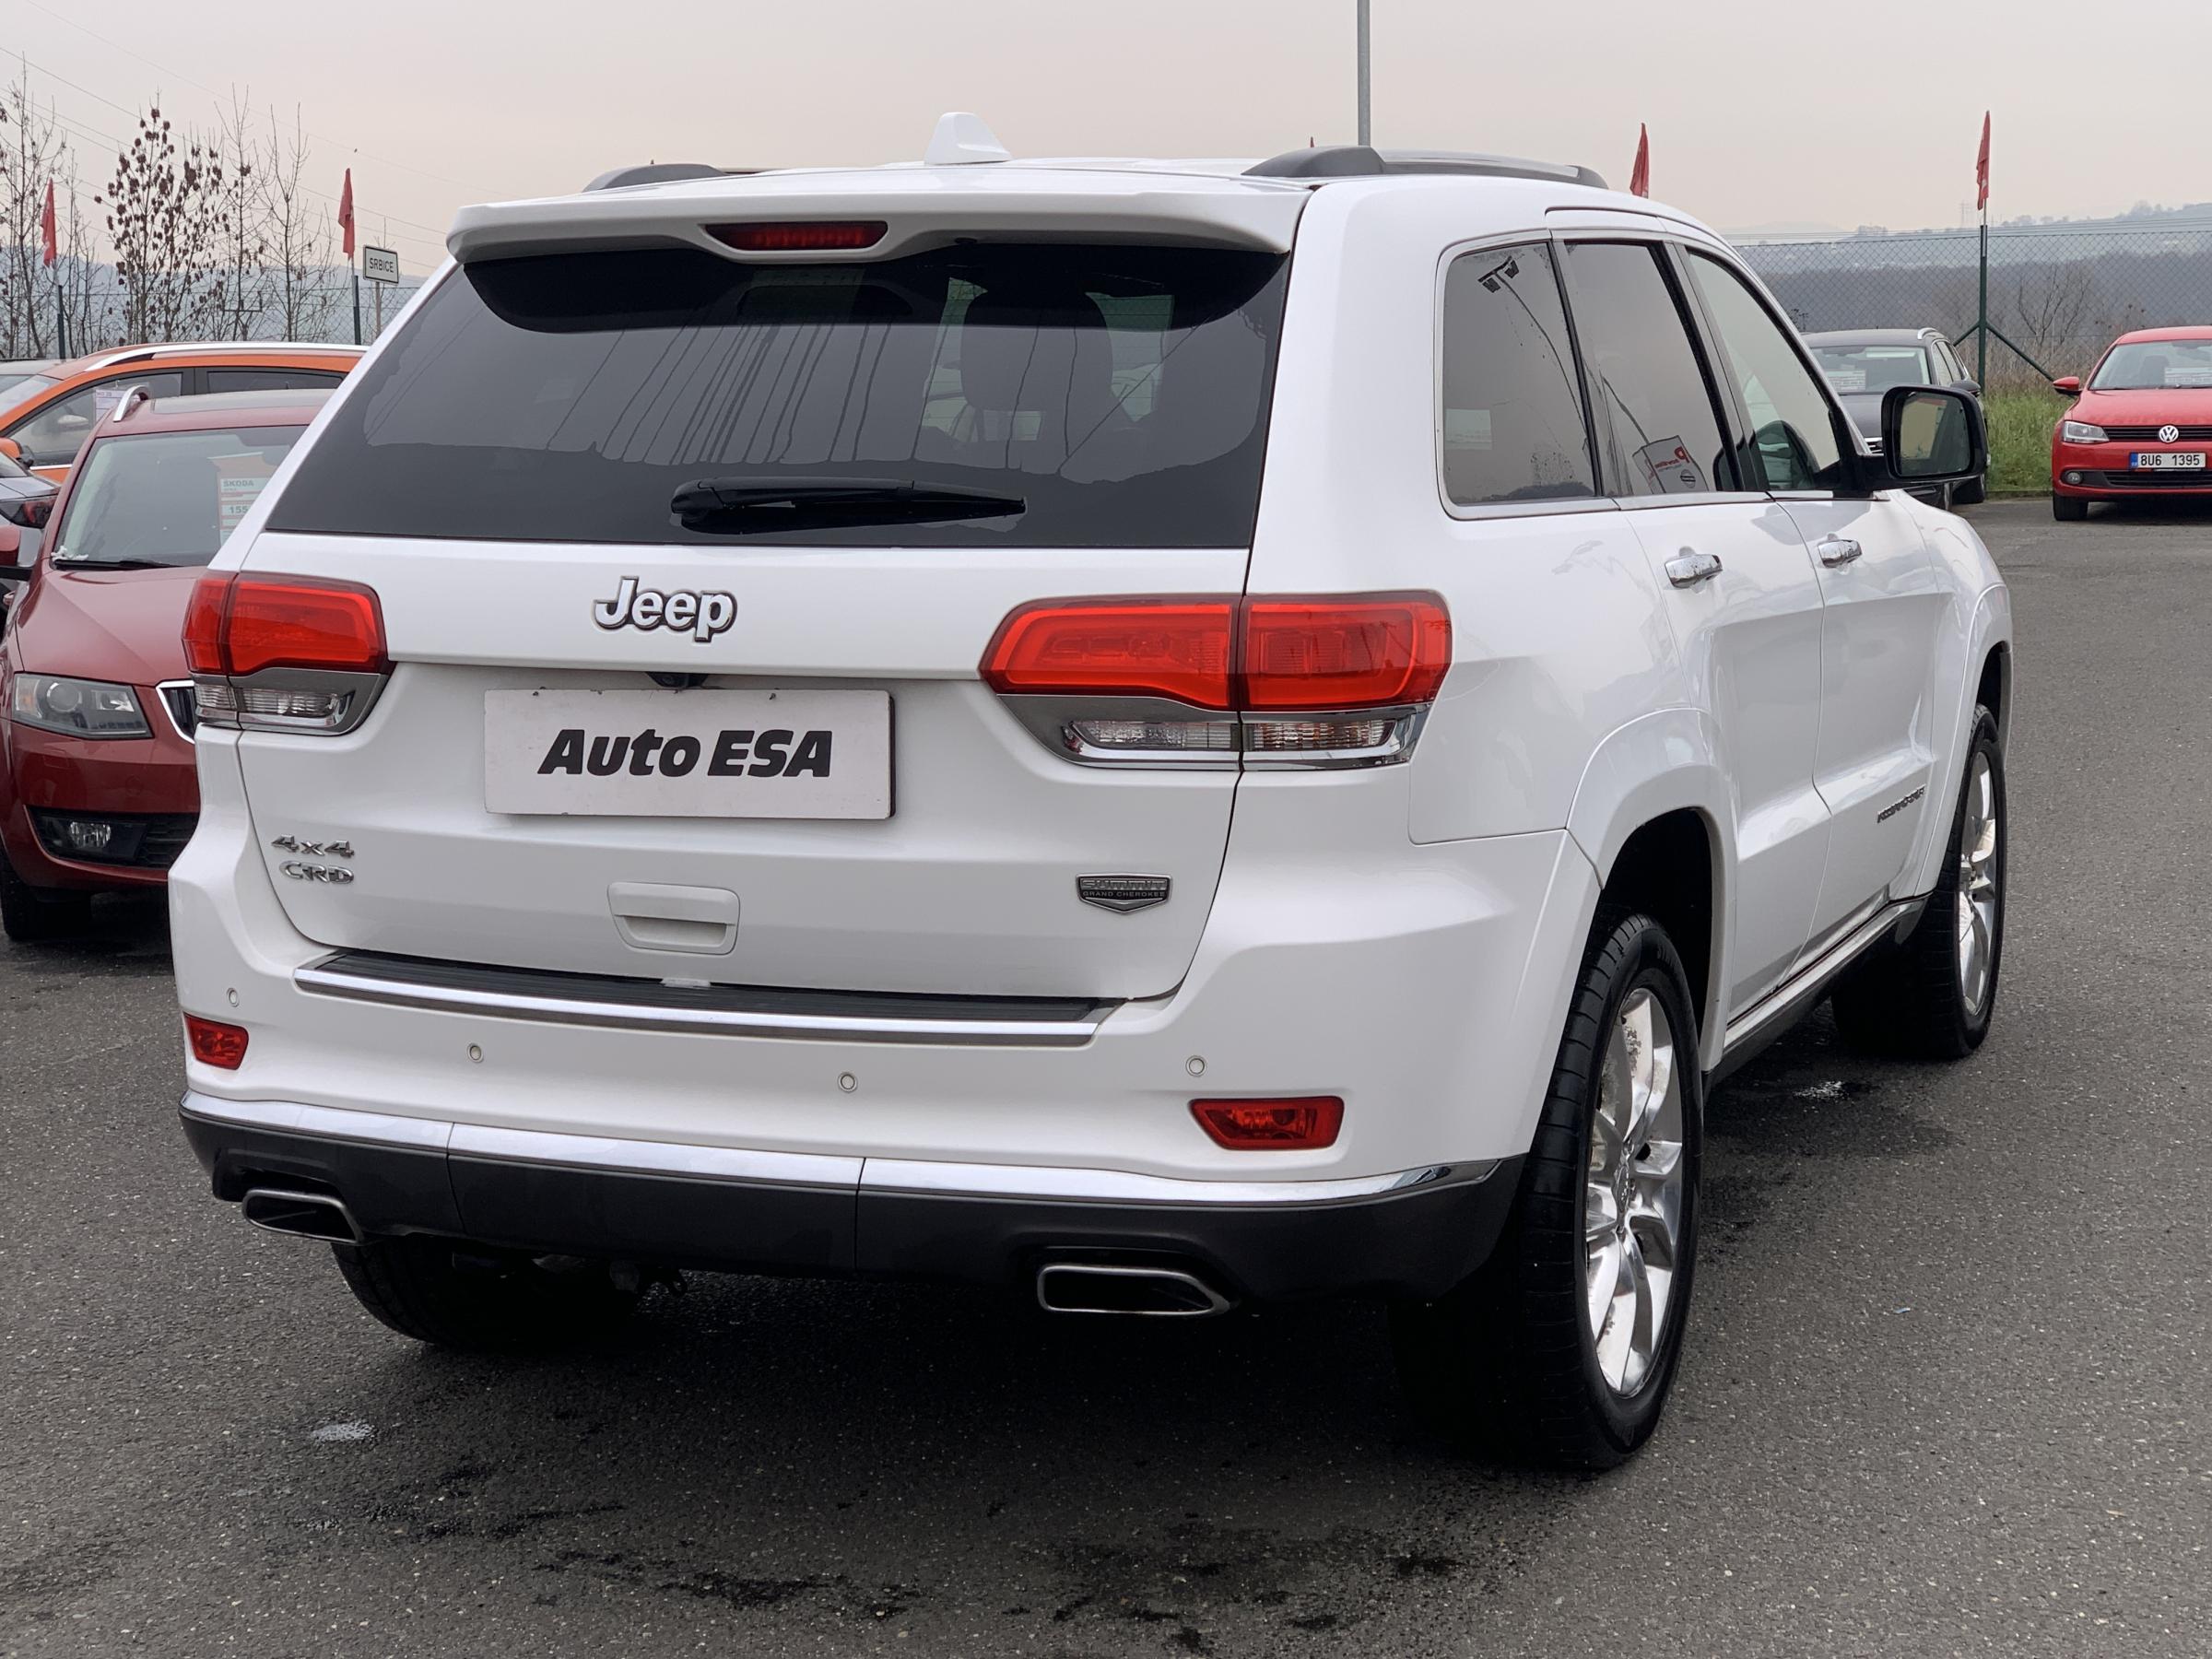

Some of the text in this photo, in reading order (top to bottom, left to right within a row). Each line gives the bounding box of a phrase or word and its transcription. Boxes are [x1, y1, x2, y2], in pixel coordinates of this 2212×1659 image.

[369, 257, 394, 274] SRBICE
[2140, 454, 2162, 466] 8U6
[2171, 454, 2200, 466] 1395
[592, 575, 738, 643] Jeep
[536, 728, 833, 778] Auto ESA
[271, 833, 356, 859] 4x4
[279, 860, 355, 885] CRD
